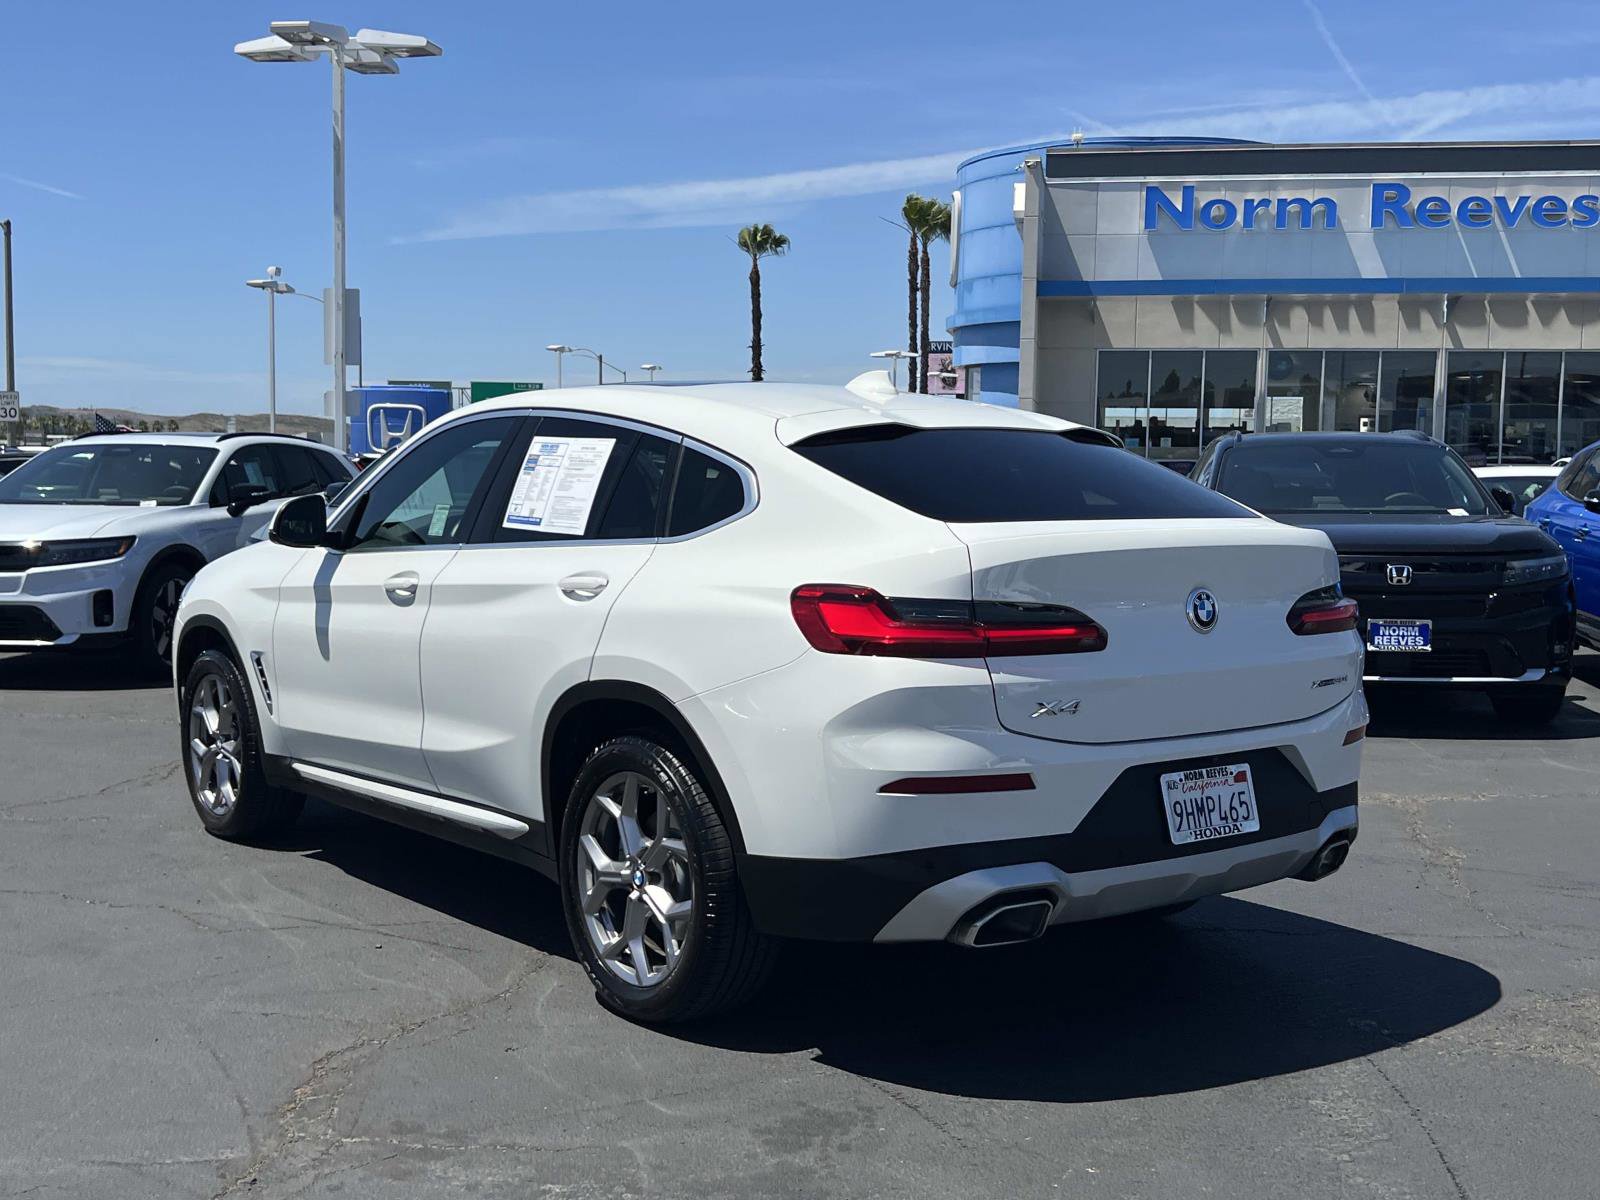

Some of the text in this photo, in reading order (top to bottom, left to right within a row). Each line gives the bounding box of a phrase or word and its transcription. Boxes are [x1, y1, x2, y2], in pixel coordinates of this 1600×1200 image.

[1144, 182, 1600, 230] Norm Reeves
[931, 342, 953, 351] RVIN
[0, 407, 17, 418] 30
[1380, 626, 1419, 636] NORM
[1374, 636, 1424, 646] REEVES
[1031, 699, 1081, 718] X4
[1183, 766, 1229, 782] NORM REEVES
[1181, 778, 1234, 796] California
[1172, 791, 1251, 832] 9HMP465
[1193, 823, 1243, 840] HONDA
